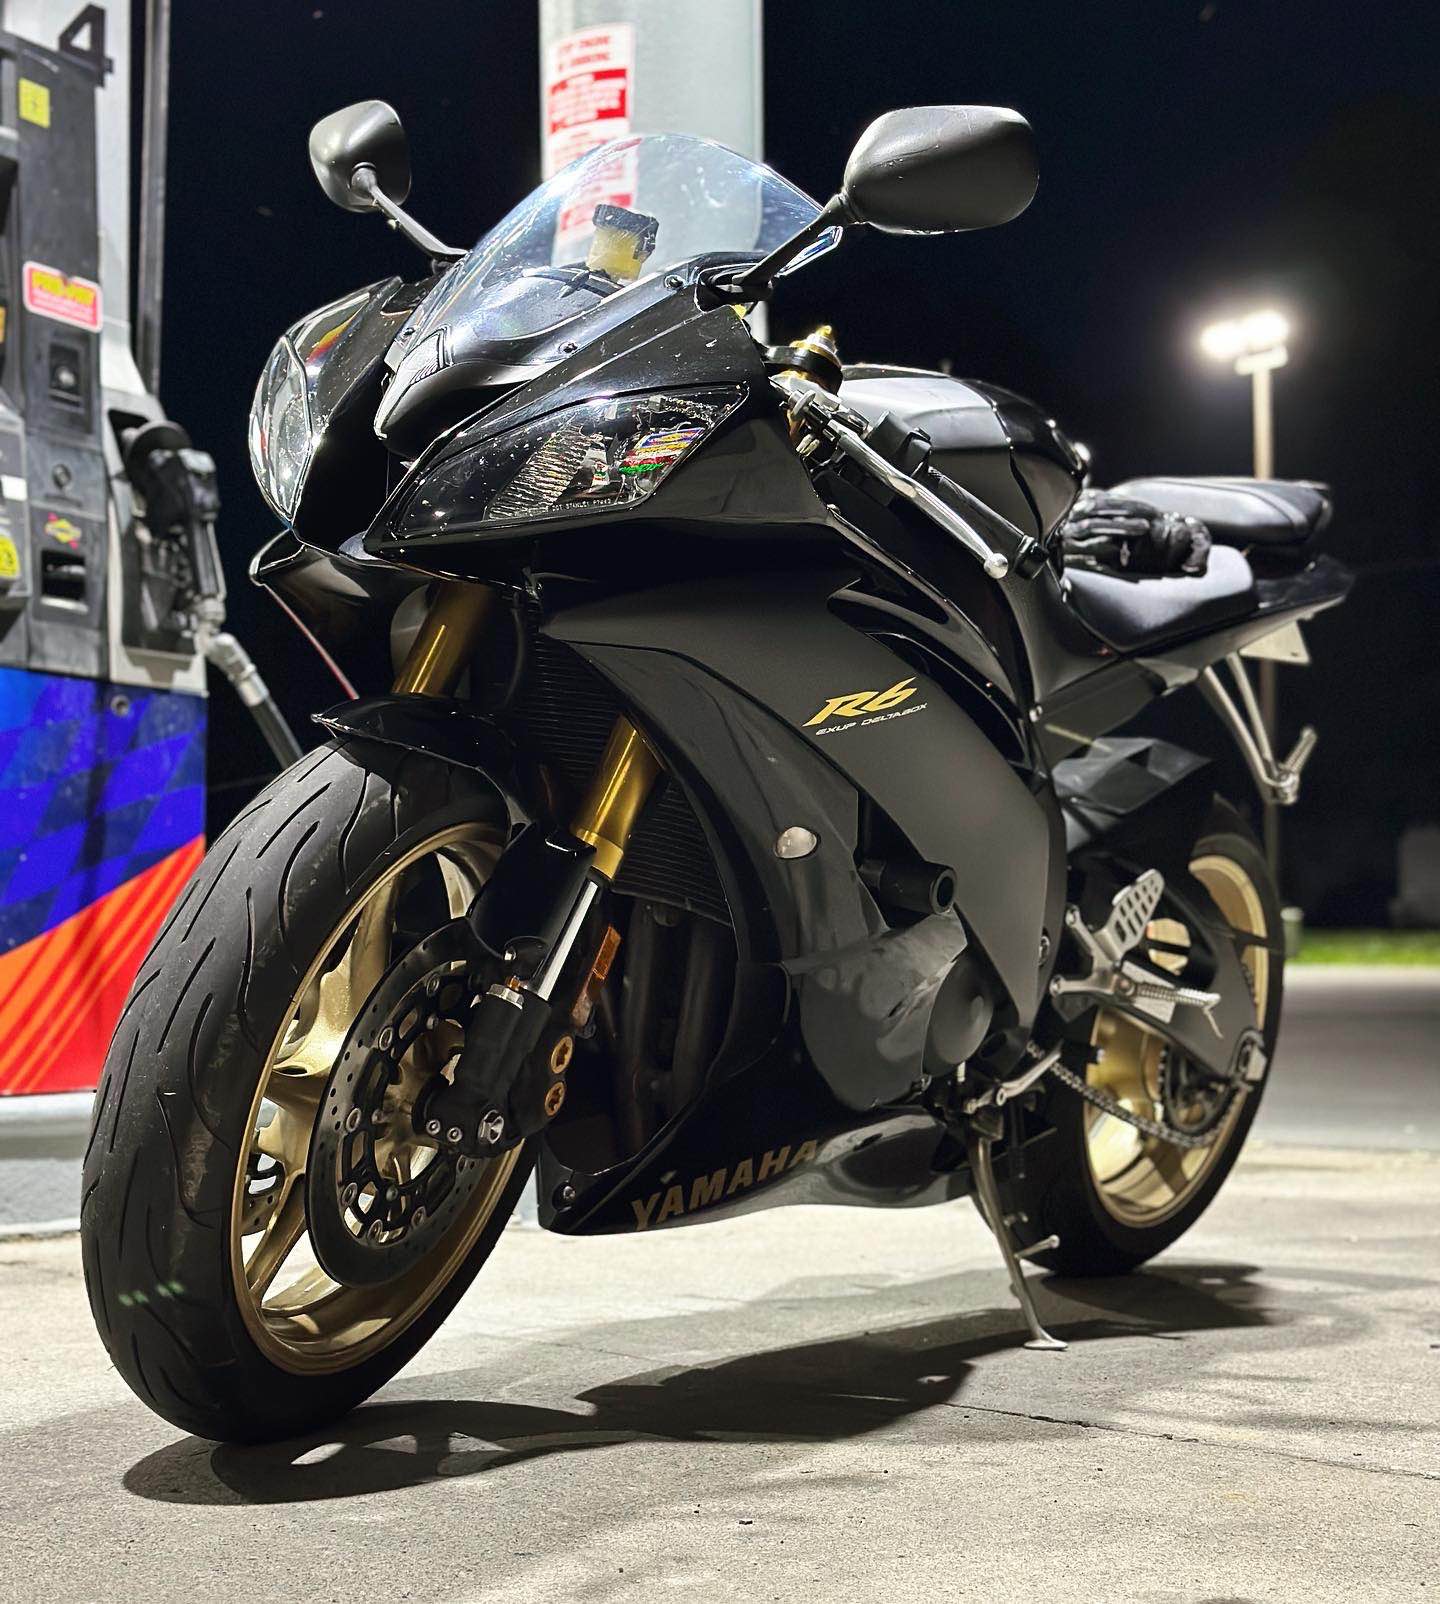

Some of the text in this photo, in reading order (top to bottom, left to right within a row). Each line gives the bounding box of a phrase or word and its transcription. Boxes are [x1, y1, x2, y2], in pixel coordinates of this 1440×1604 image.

[801, 676, 918, 727] R6
[815, 702, 928, 736] EXUP DELTABOX
[631, 1139, 817, 1232] YAMAHA
